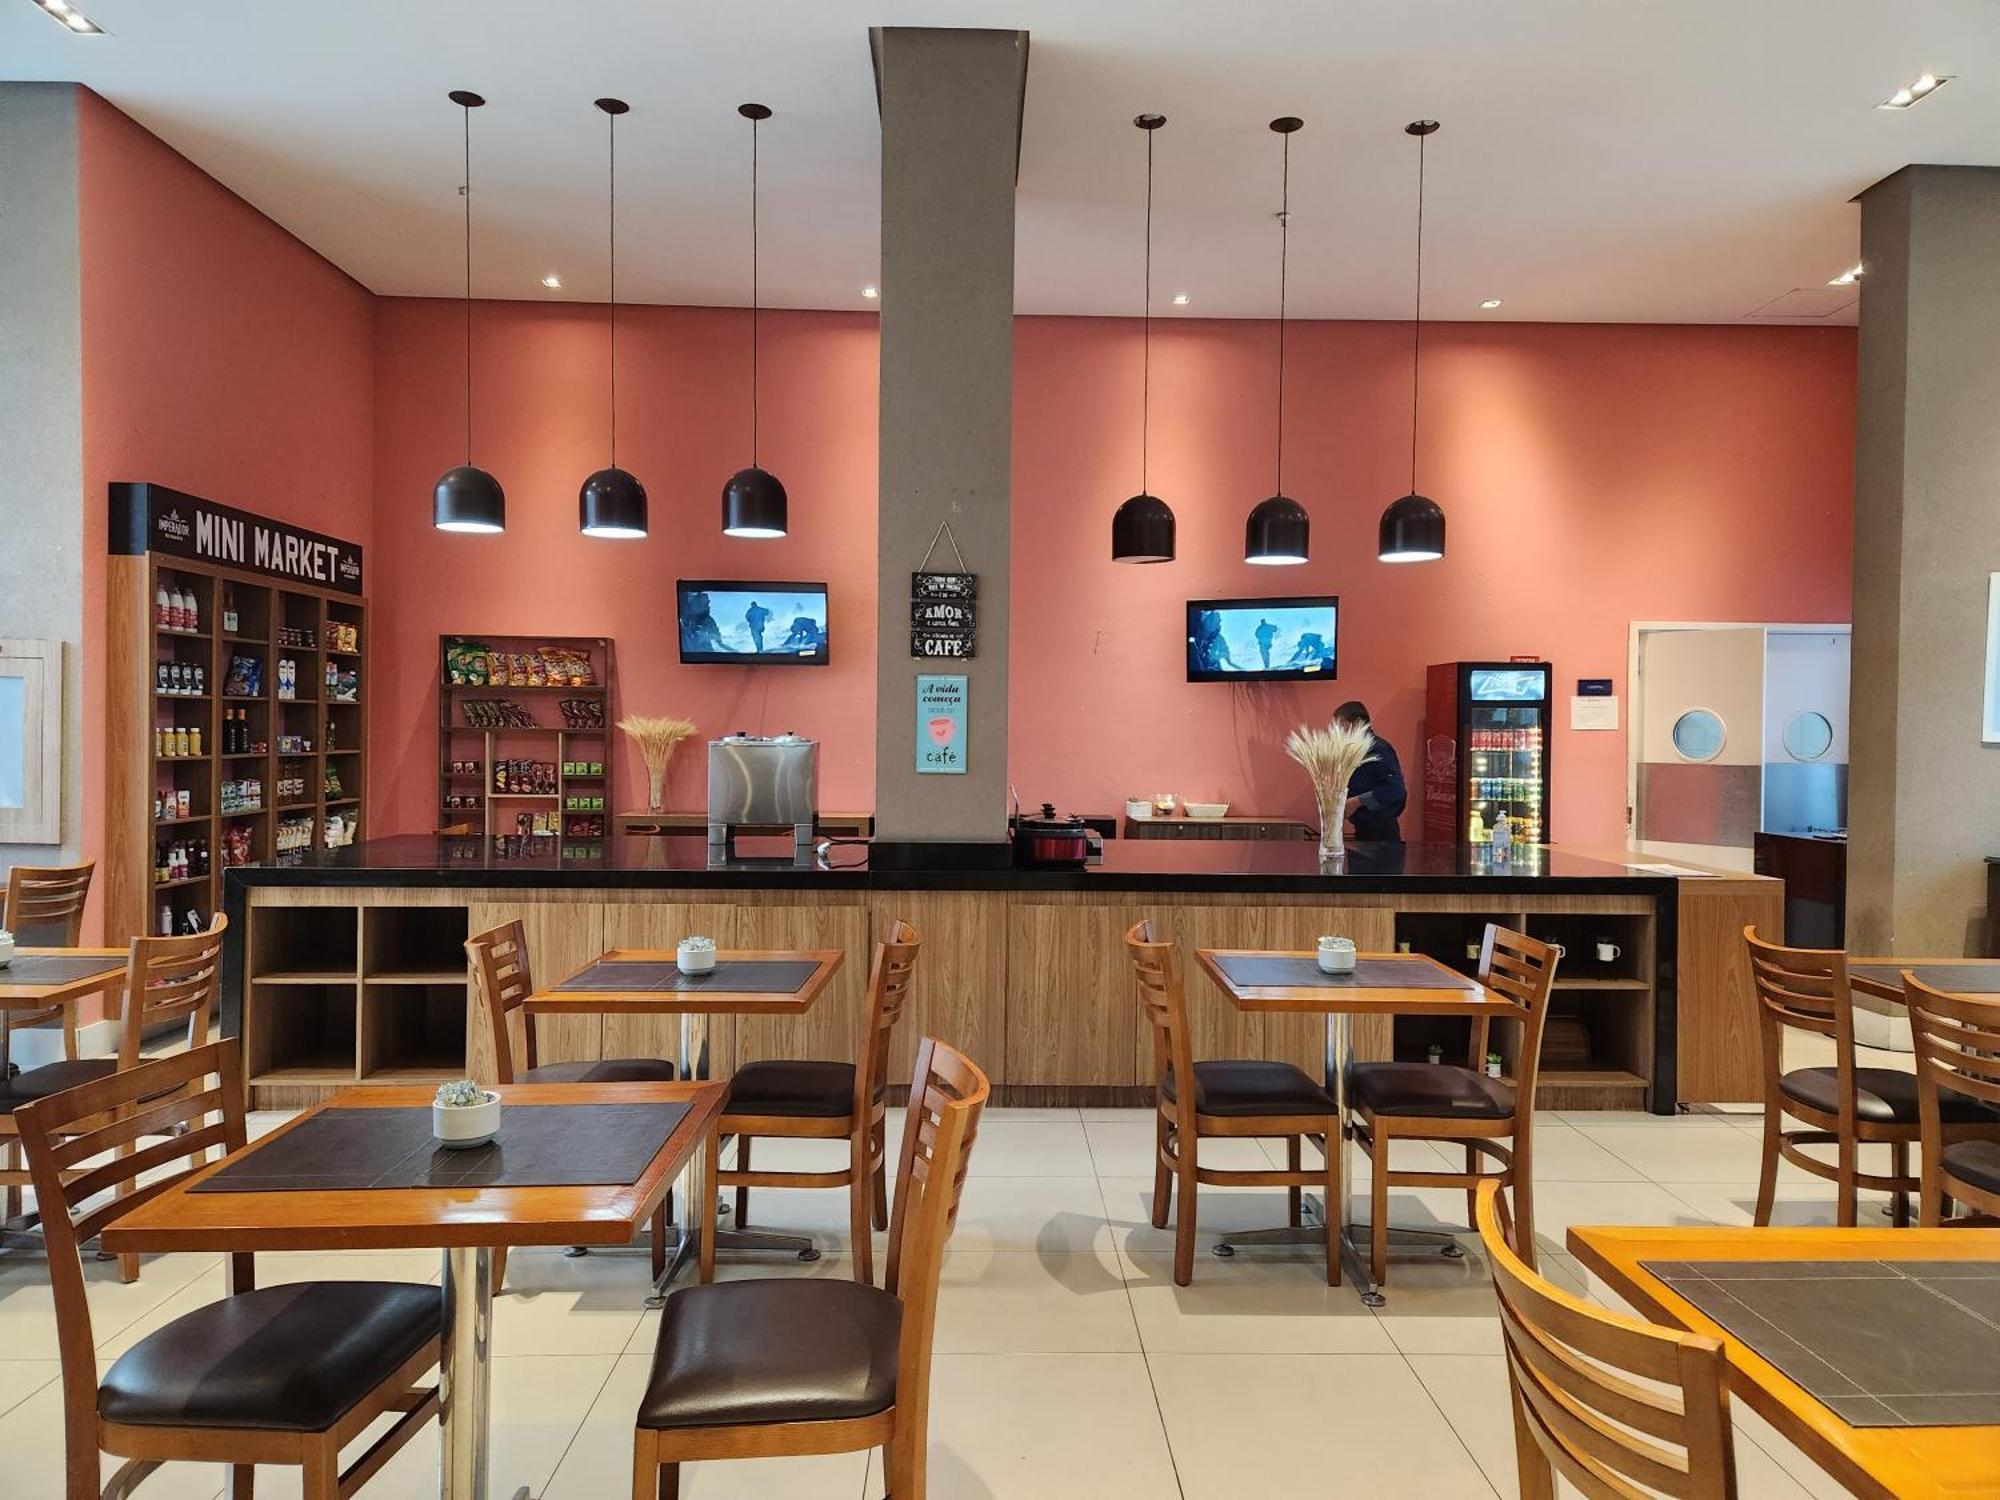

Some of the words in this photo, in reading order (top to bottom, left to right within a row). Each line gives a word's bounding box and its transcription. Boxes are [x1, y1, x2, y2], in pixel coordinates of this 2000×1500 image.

[196, 510, 244, 563] MINI
[255, 526, 339, 583] MARKET
[925, 604, 963, 619] AMOR
[925, 639, 963, 655] CAFÉ
[922, 683, 935, 694] A
[936, 683, 960, 694] vida
[923, 695, 961, 706] começa
[926, 746, 957, 764] café
